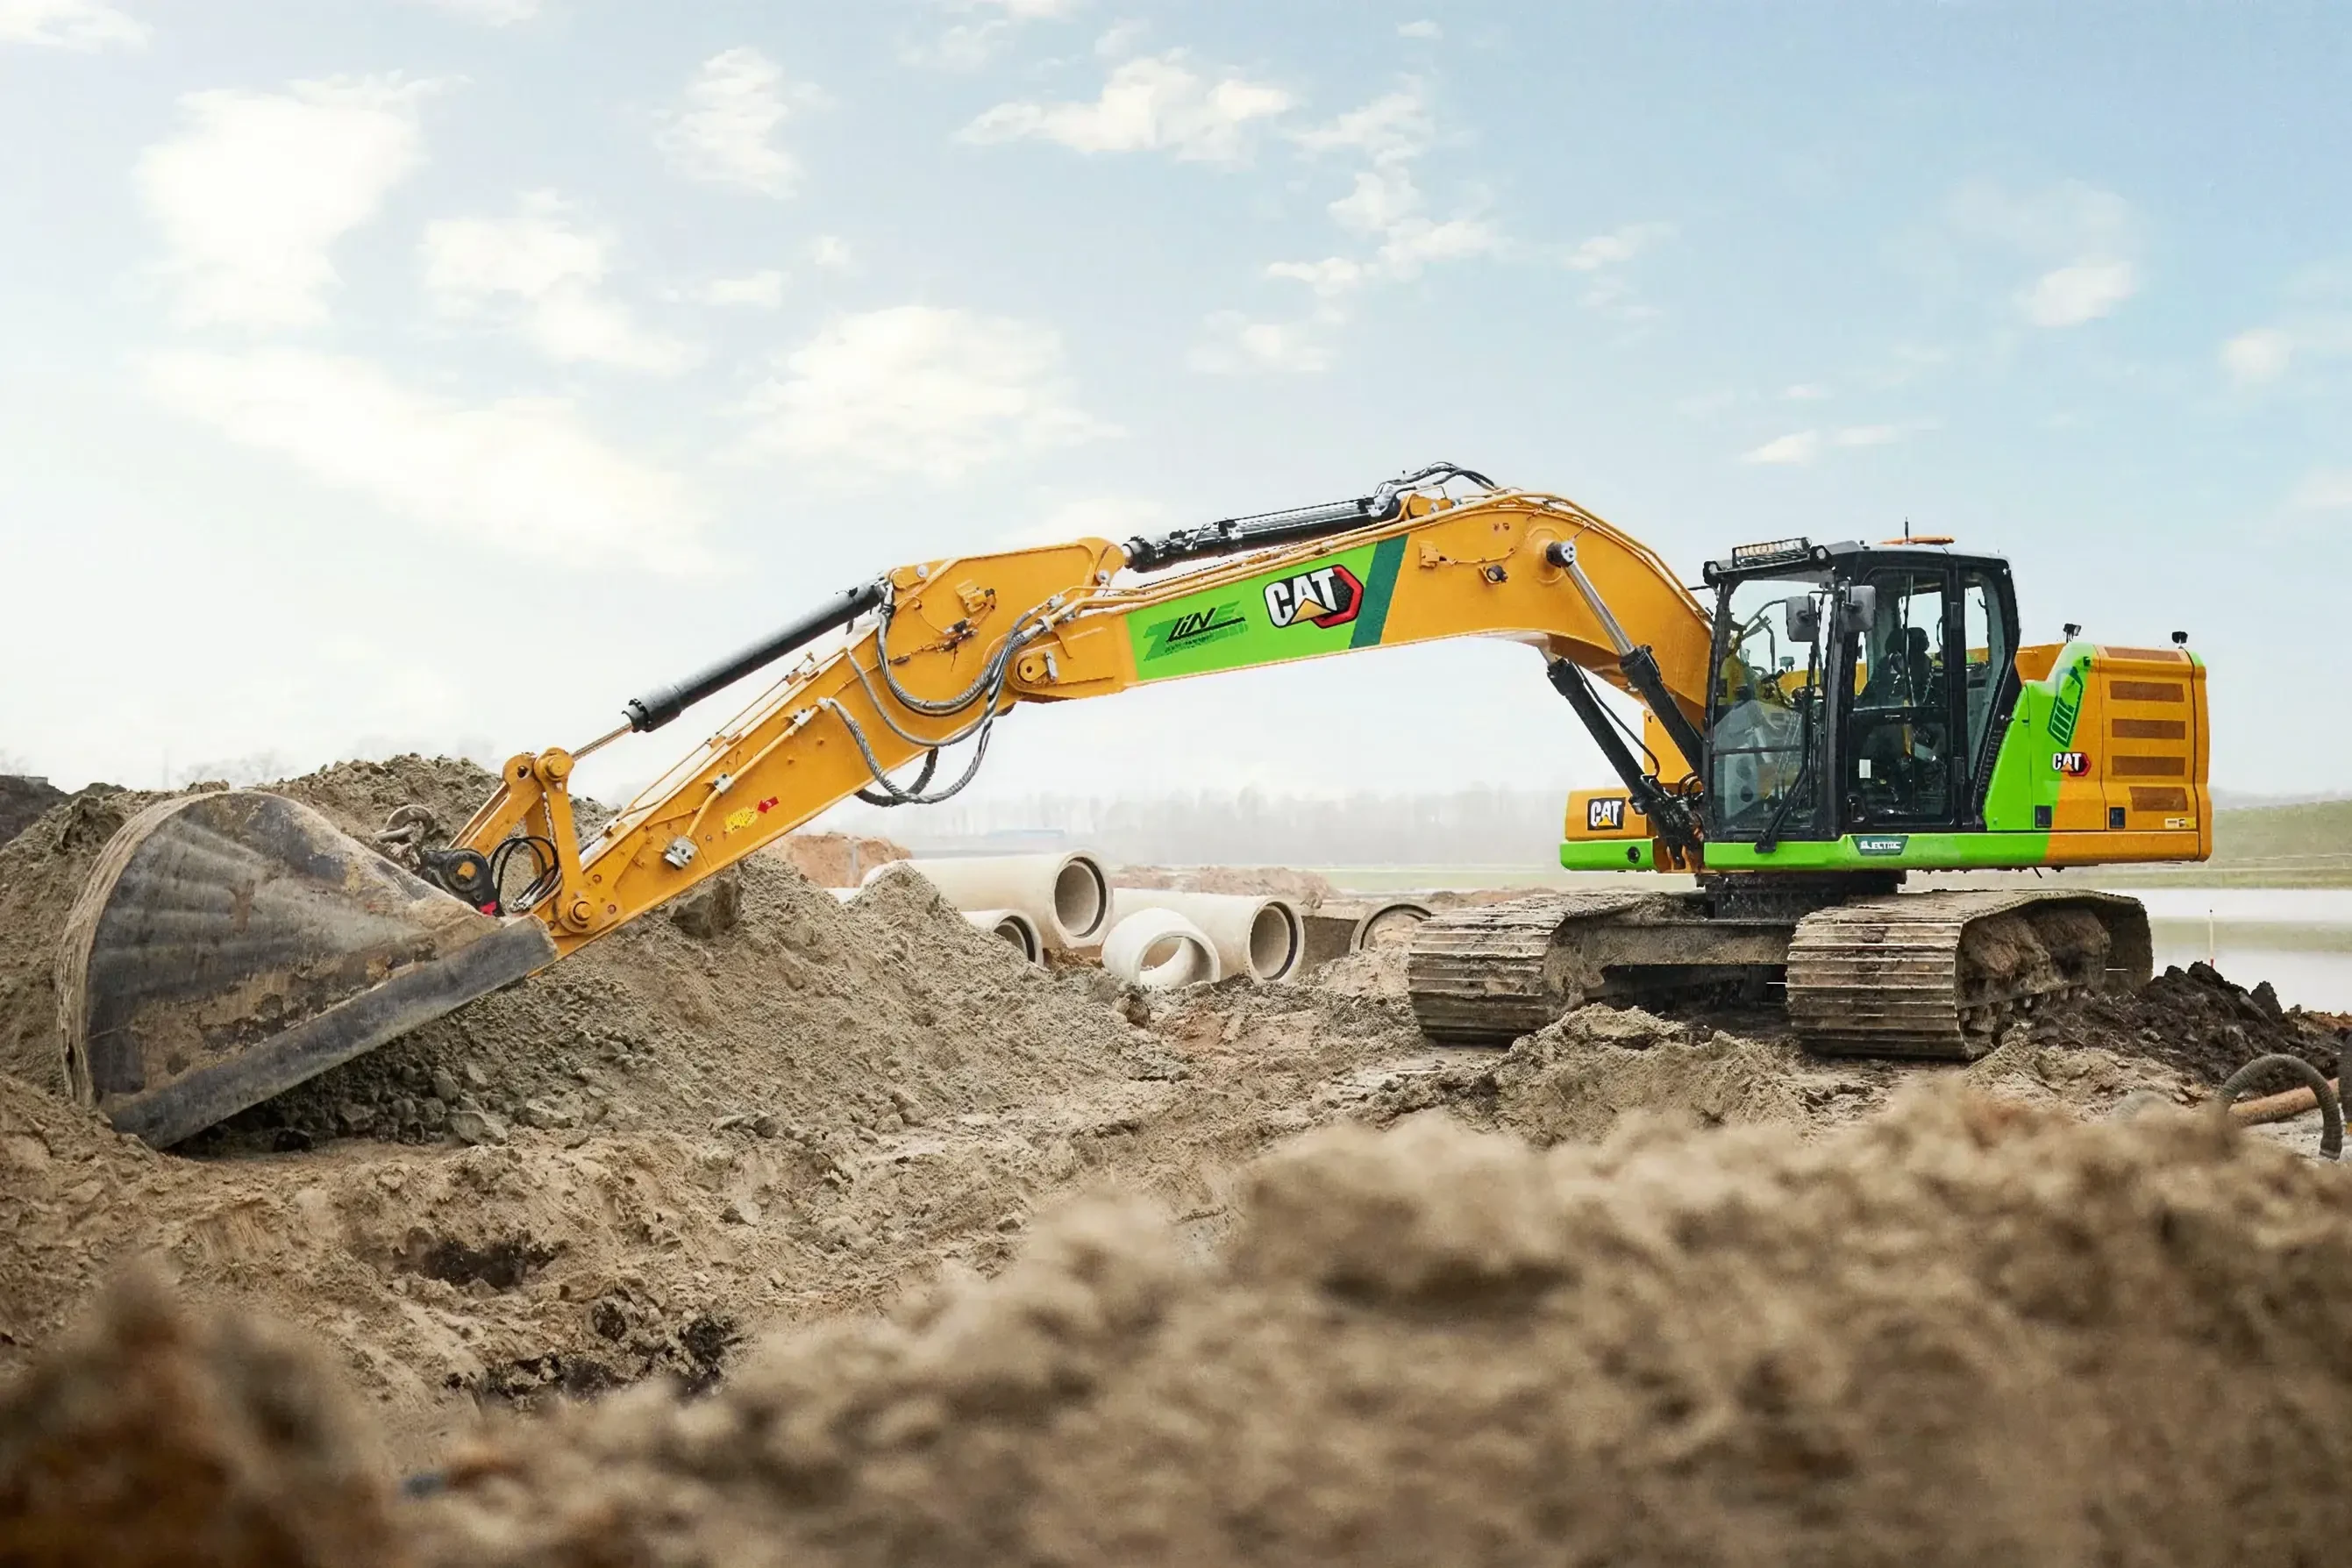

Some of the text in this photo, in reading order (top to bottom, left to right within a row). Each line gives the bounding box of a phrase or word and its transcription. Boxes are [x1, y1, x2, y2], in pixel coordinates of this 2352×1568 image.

[1265, 568, 1337, 626] CAT
[2052, 752, 2082, 771] CAT
[1591, 801, 1622, 827] CAT
